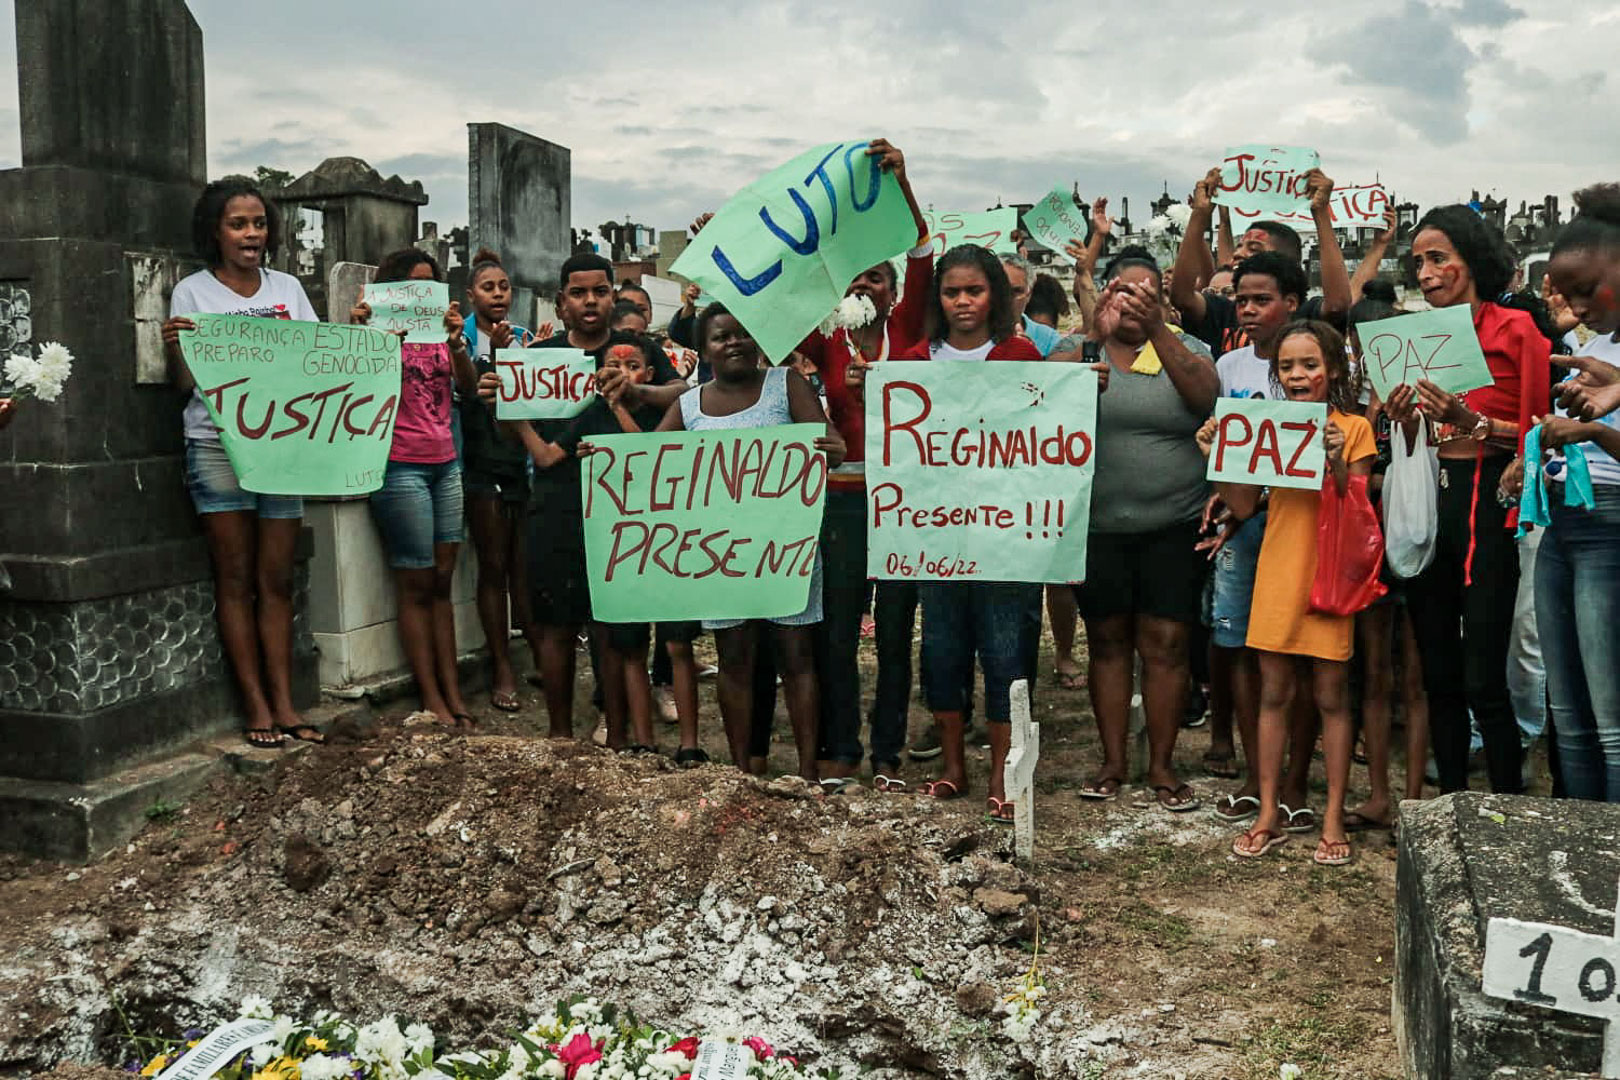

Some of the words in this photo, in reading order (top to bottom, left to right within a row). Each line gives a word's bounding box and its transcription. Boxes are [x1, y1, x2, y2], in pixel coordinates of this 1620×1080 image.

[1221, 154, 1309, 199] JUSTIÇ
[711, 142, 882, 296] LUTO
[391, 303, 408, 313] DE
[414, 306, 444, 316] DEUS
[192, 341, 275, 363] PREPARO
[314, 324, 399, 353] ESTADO
[1369, 333, 1462, 382] PAZ
[1214, 412, 1318, 478] PAZ
